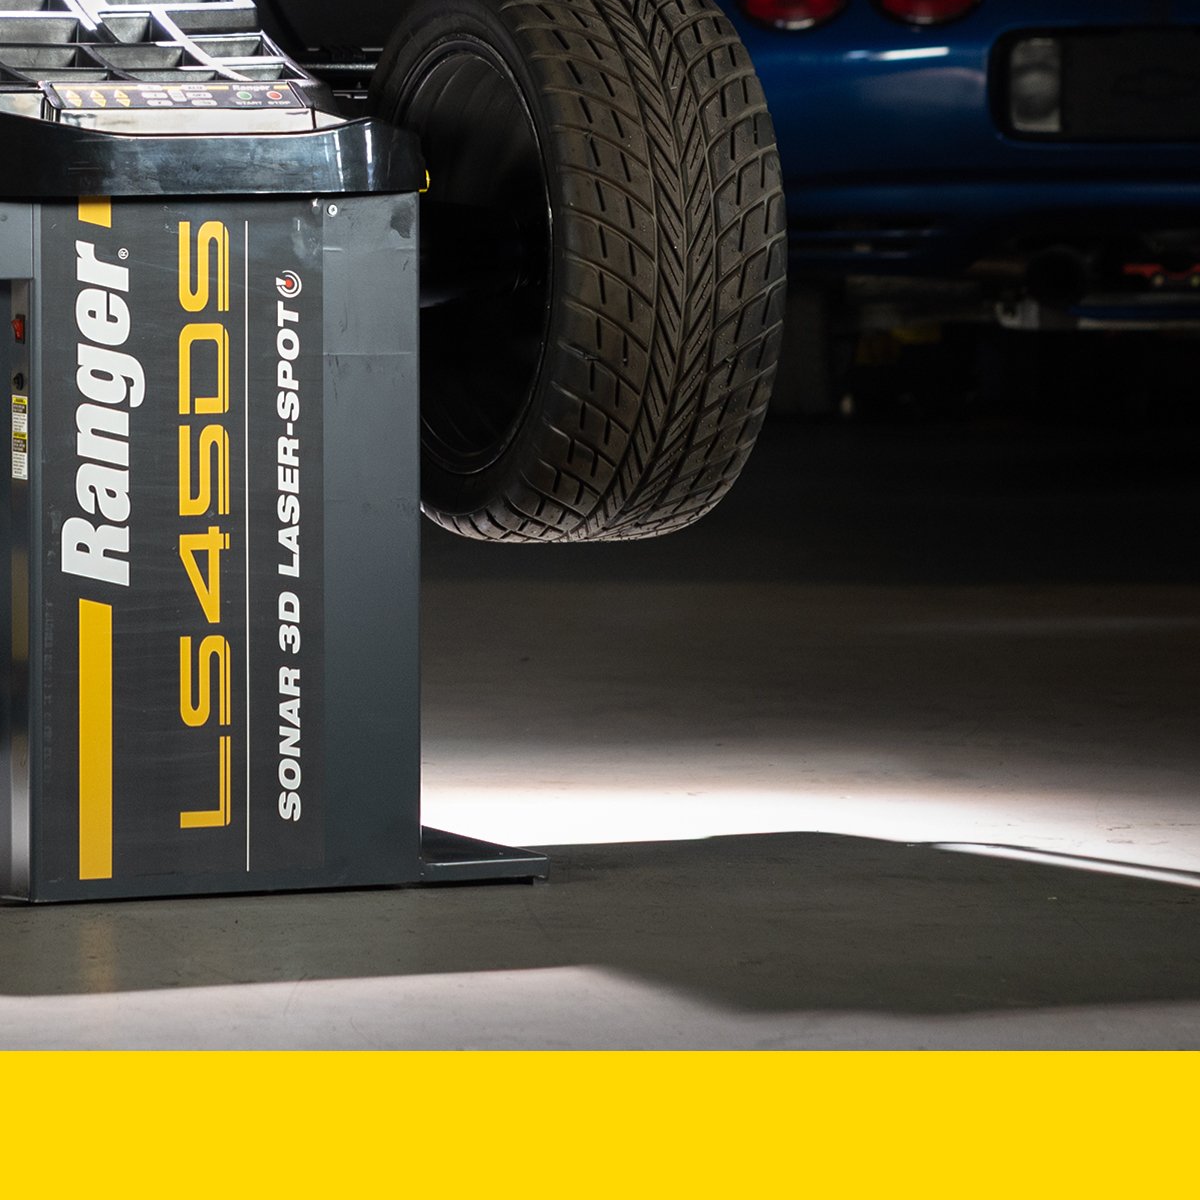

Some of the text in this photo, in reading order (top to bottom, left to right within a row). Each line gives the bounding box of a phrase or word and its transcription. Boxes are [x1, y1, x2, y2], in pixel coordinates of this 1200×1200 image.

[179, 221, 230, 828] LS45DS
[278, 302, 302, 822] SONAR 3D LASER-SPOT
